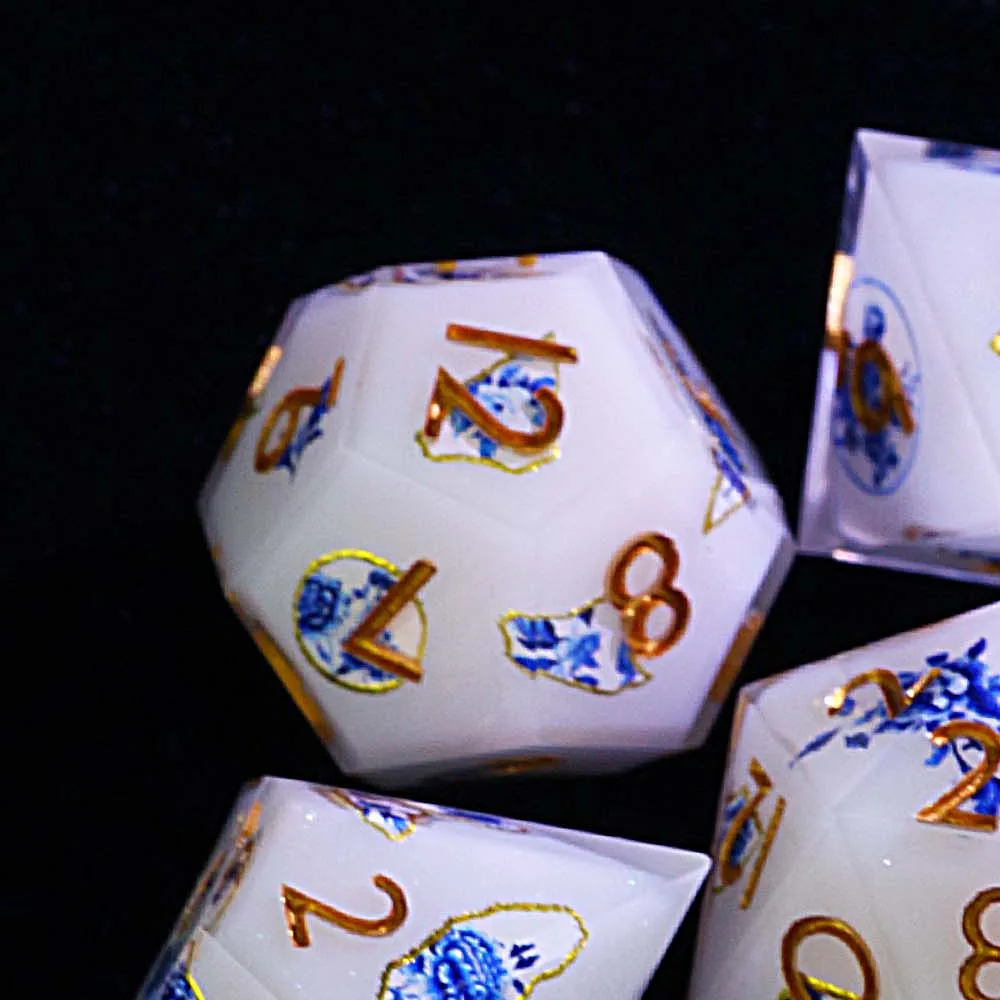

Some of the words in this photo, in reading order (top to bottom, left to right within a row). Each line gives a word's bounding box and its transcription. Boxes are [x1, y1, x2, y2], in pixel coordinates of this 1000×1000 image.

[423, 322, 579, 455] 12
[342, 558, 438, 684] 7
[607, 531, 692, 660] 8
[823, 667, 942, 720] 2
[279, 873, 409, 949] 2
